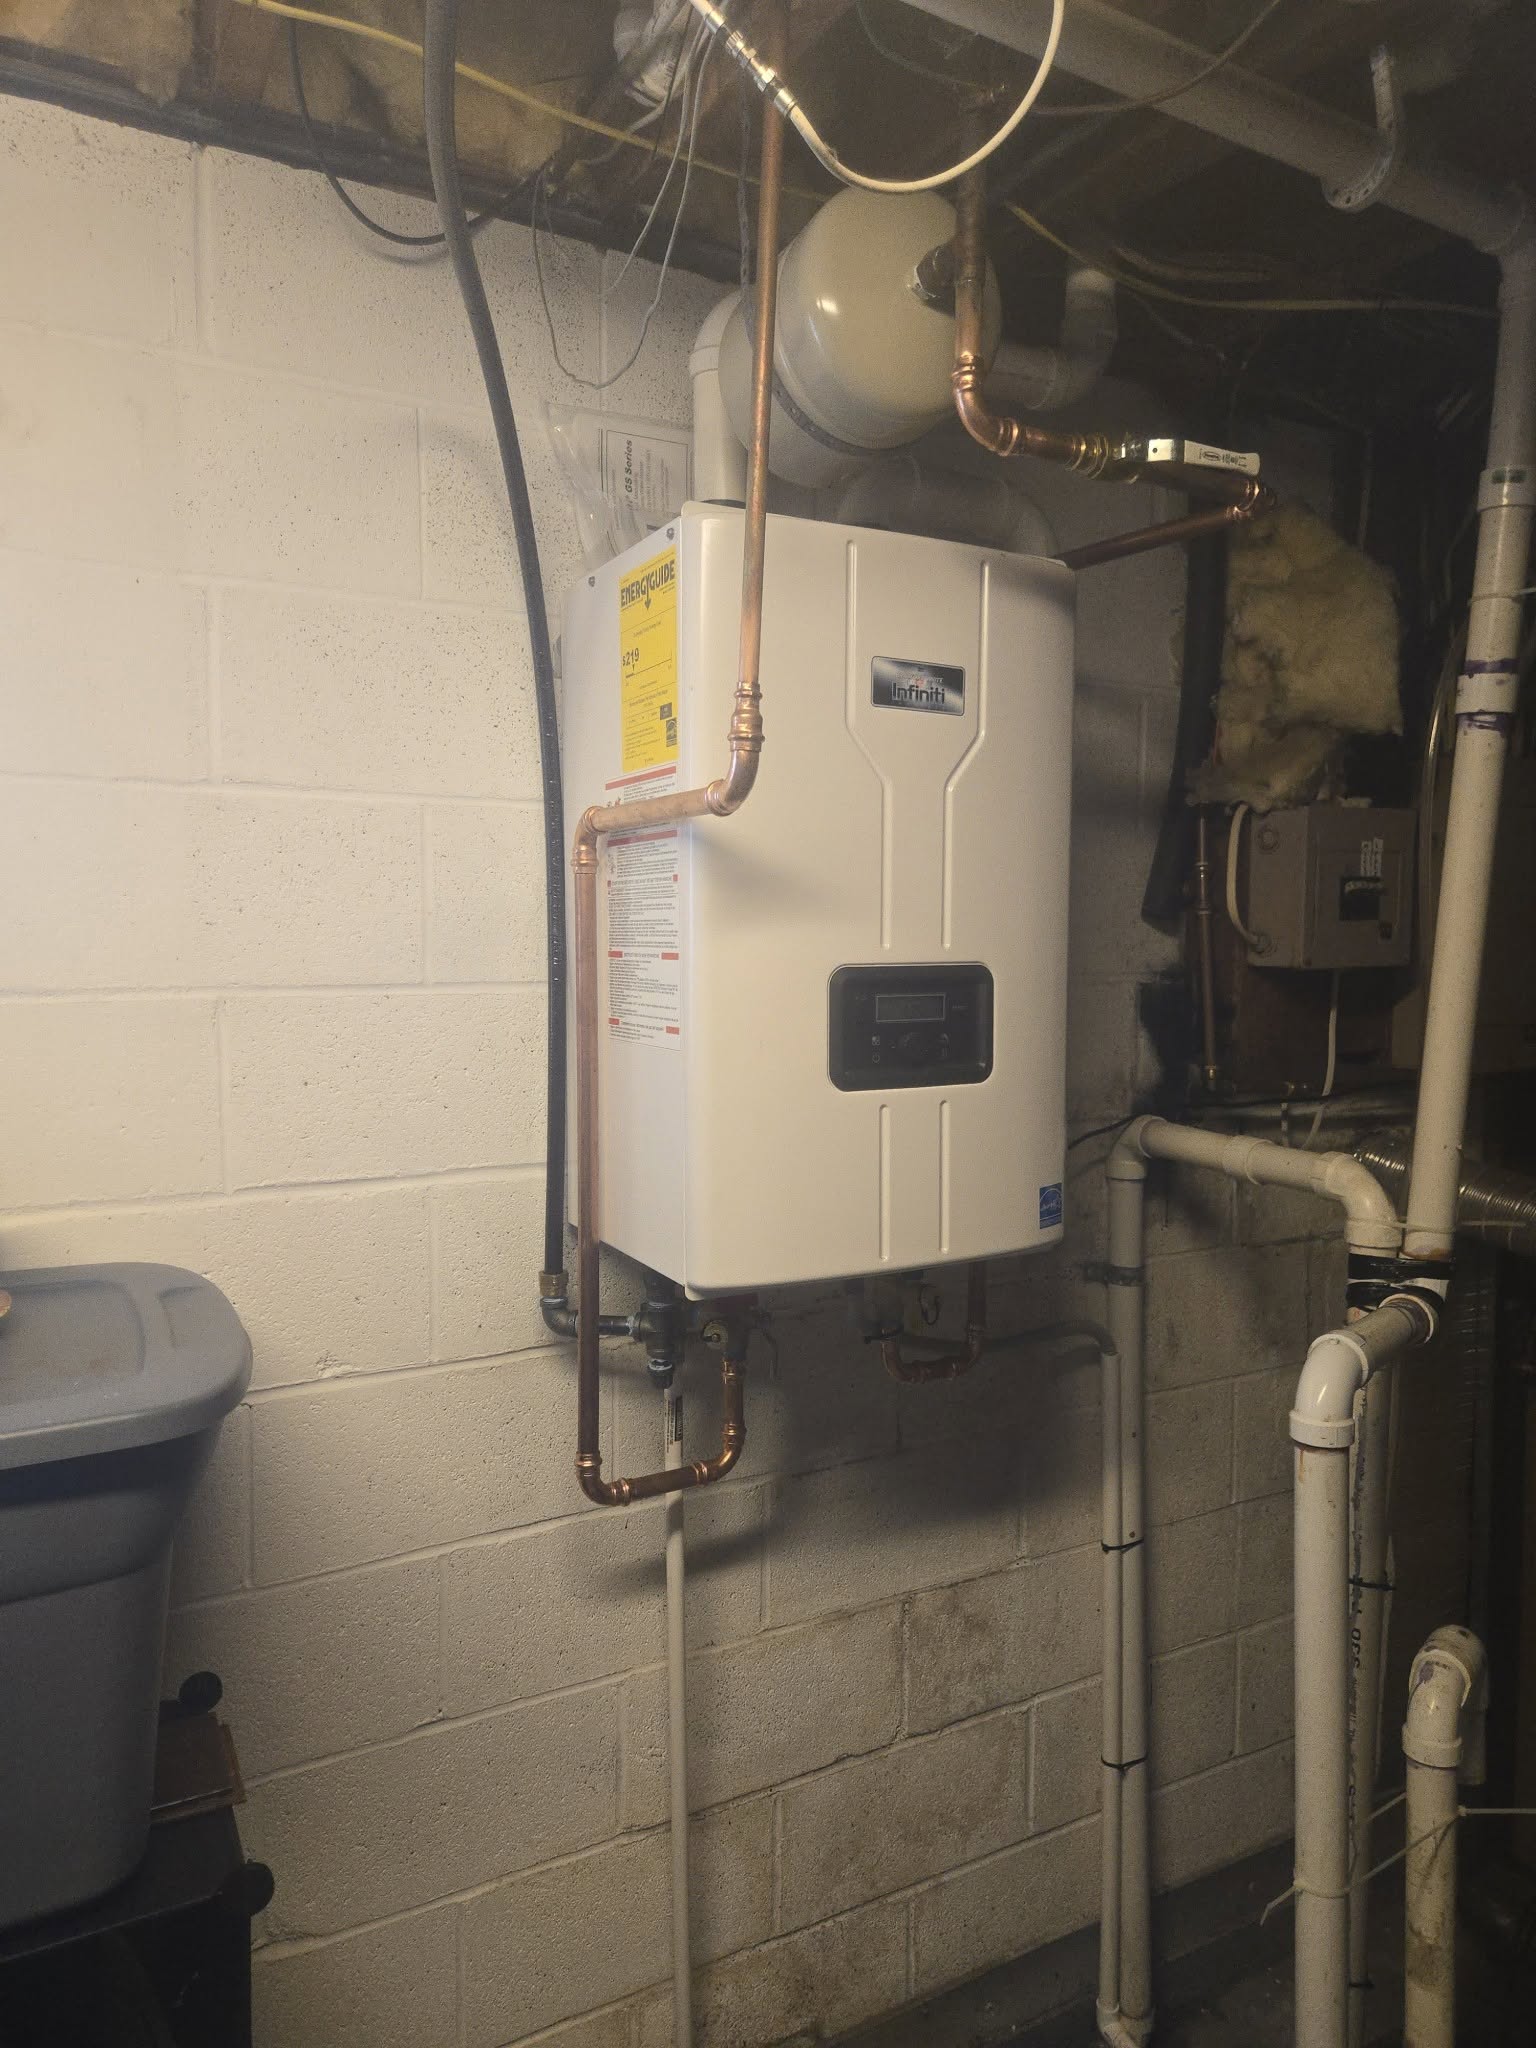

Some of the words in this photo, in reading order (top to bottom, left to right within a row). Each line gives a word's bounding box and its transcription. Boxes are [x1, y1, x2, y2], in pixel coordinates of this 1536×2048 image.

[624, 440, 633, 475] Series
[624, 477, 633, 493] GS
[620, 559, 675, 608] ENERGYGUIDE
[622, 647, 640, 667] $219
[891, 682, 945, 705] Infiniti
